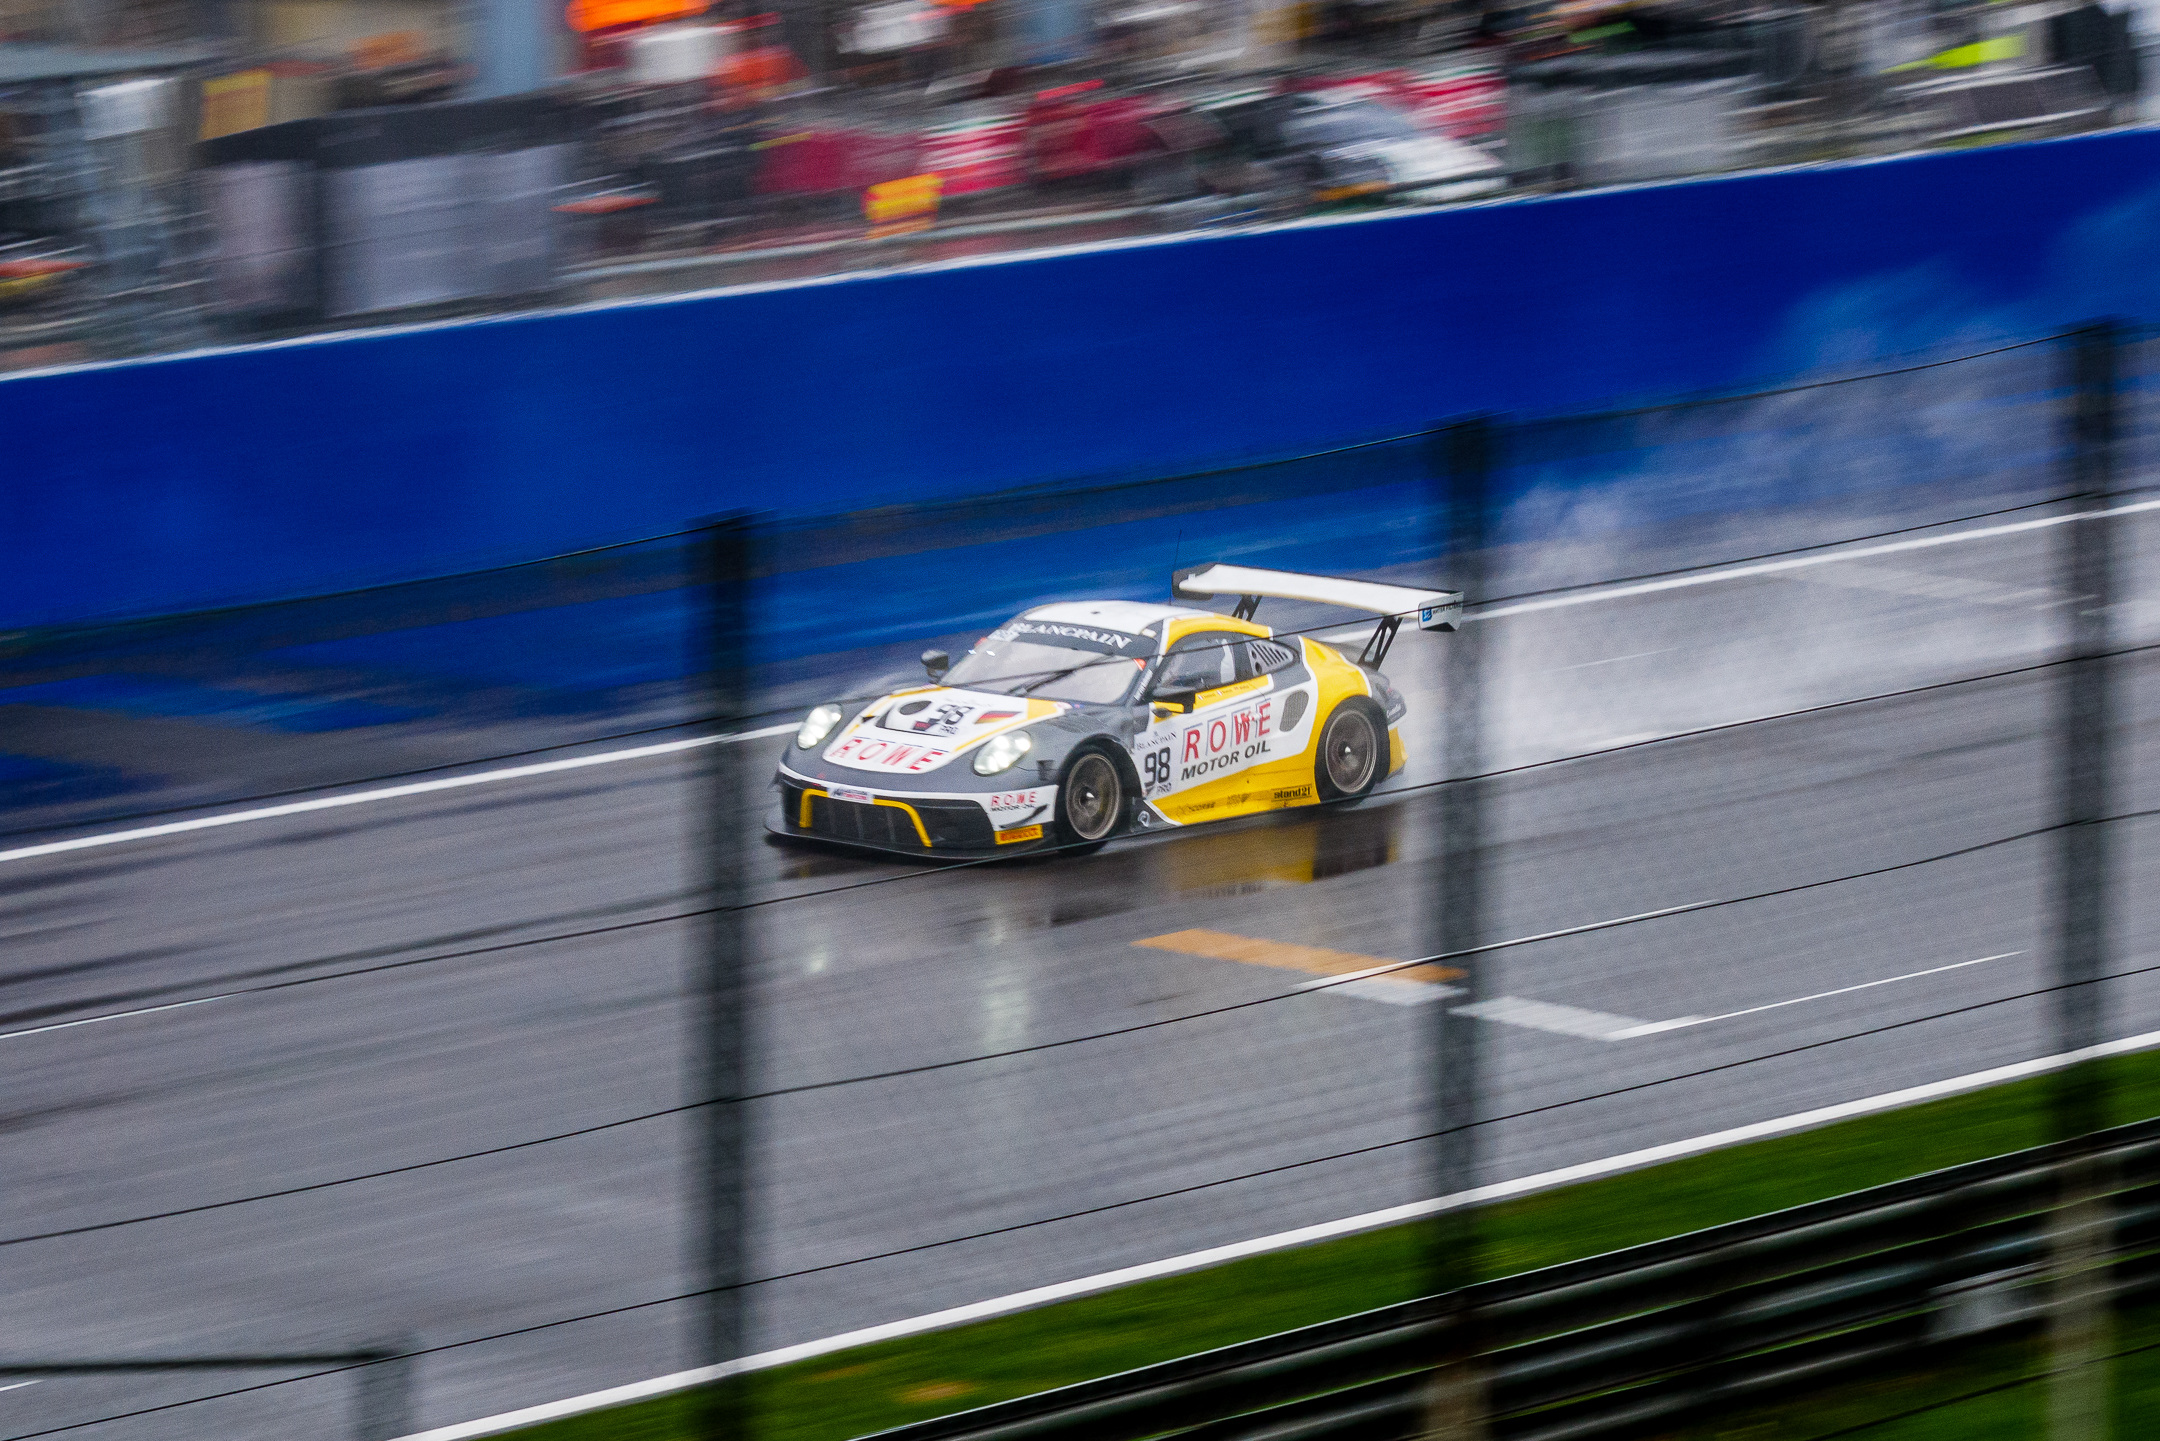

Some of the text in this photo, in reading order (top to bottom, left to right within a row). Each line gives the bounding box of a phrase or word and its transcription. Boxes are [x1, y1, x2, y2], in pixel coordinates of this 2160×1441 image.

[1183, 701, 1272, 763] ROWE
[829, 738, 944, 771] ROWE
[1144, 746, 1171, 788] 98
[1180, 740, 1272, 781] MOTOR OIL
[991, 791, 1037, 807] ROWE
